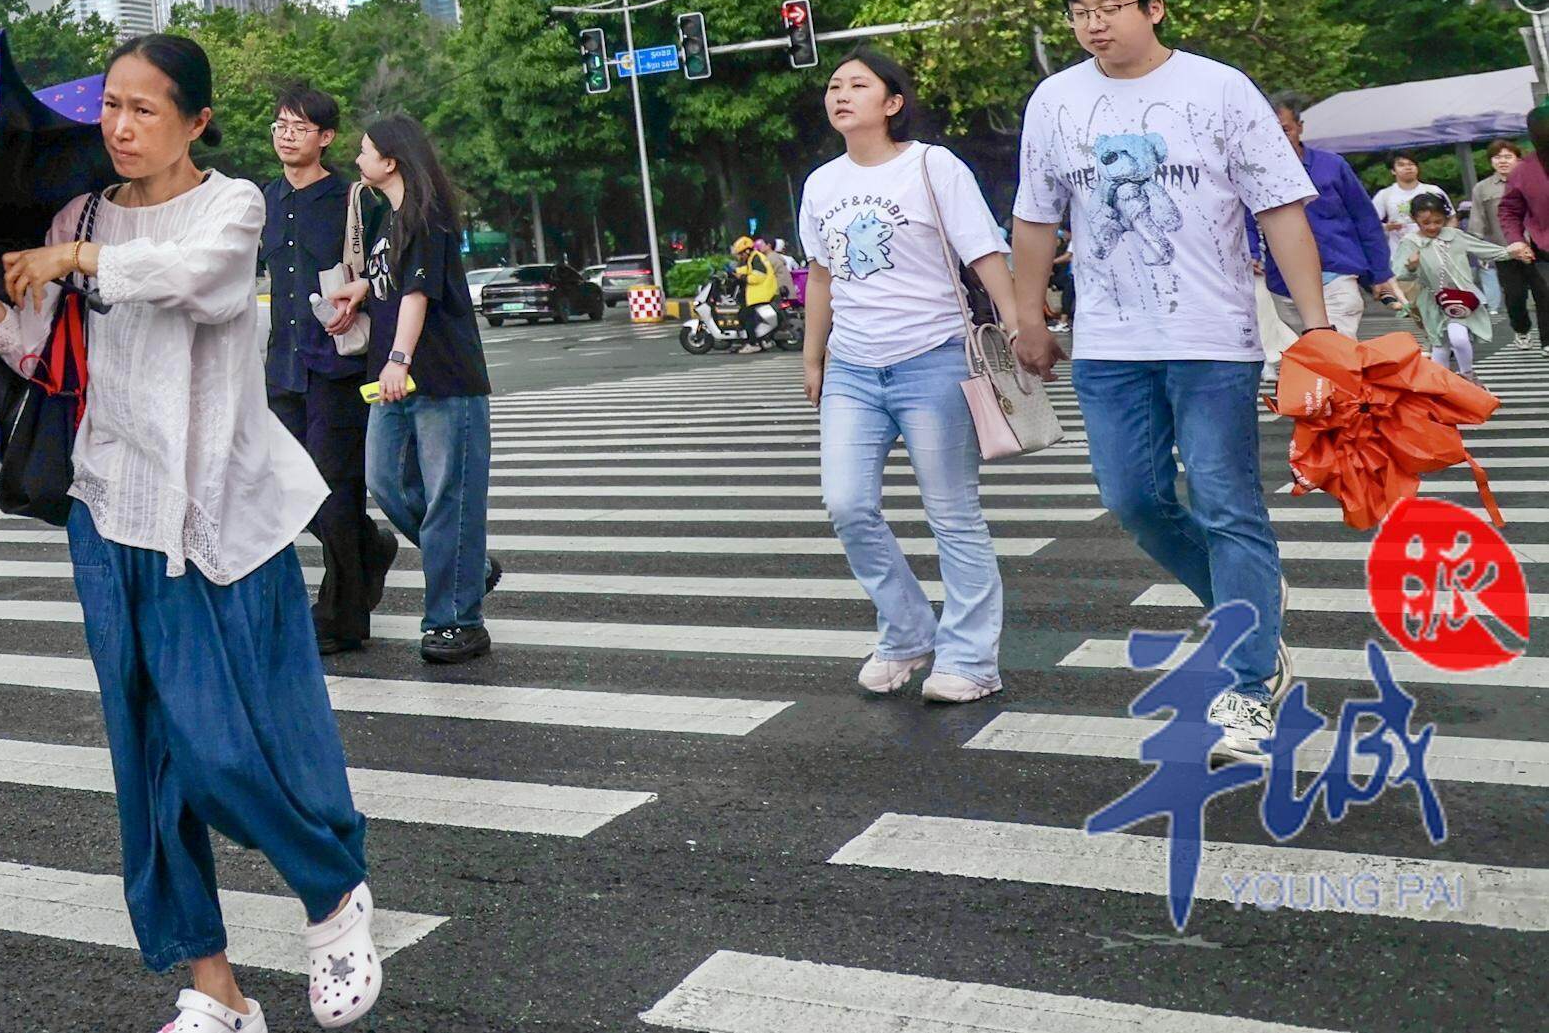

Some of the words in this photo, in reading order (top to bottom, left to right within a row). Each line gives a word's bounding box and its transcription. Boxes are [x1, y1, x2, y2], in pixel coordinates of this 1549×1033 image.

[819, 198, 848, 232] WOLF
[851, 195, 861, 206] &
[863, 195, 909, 226] RABBIT
